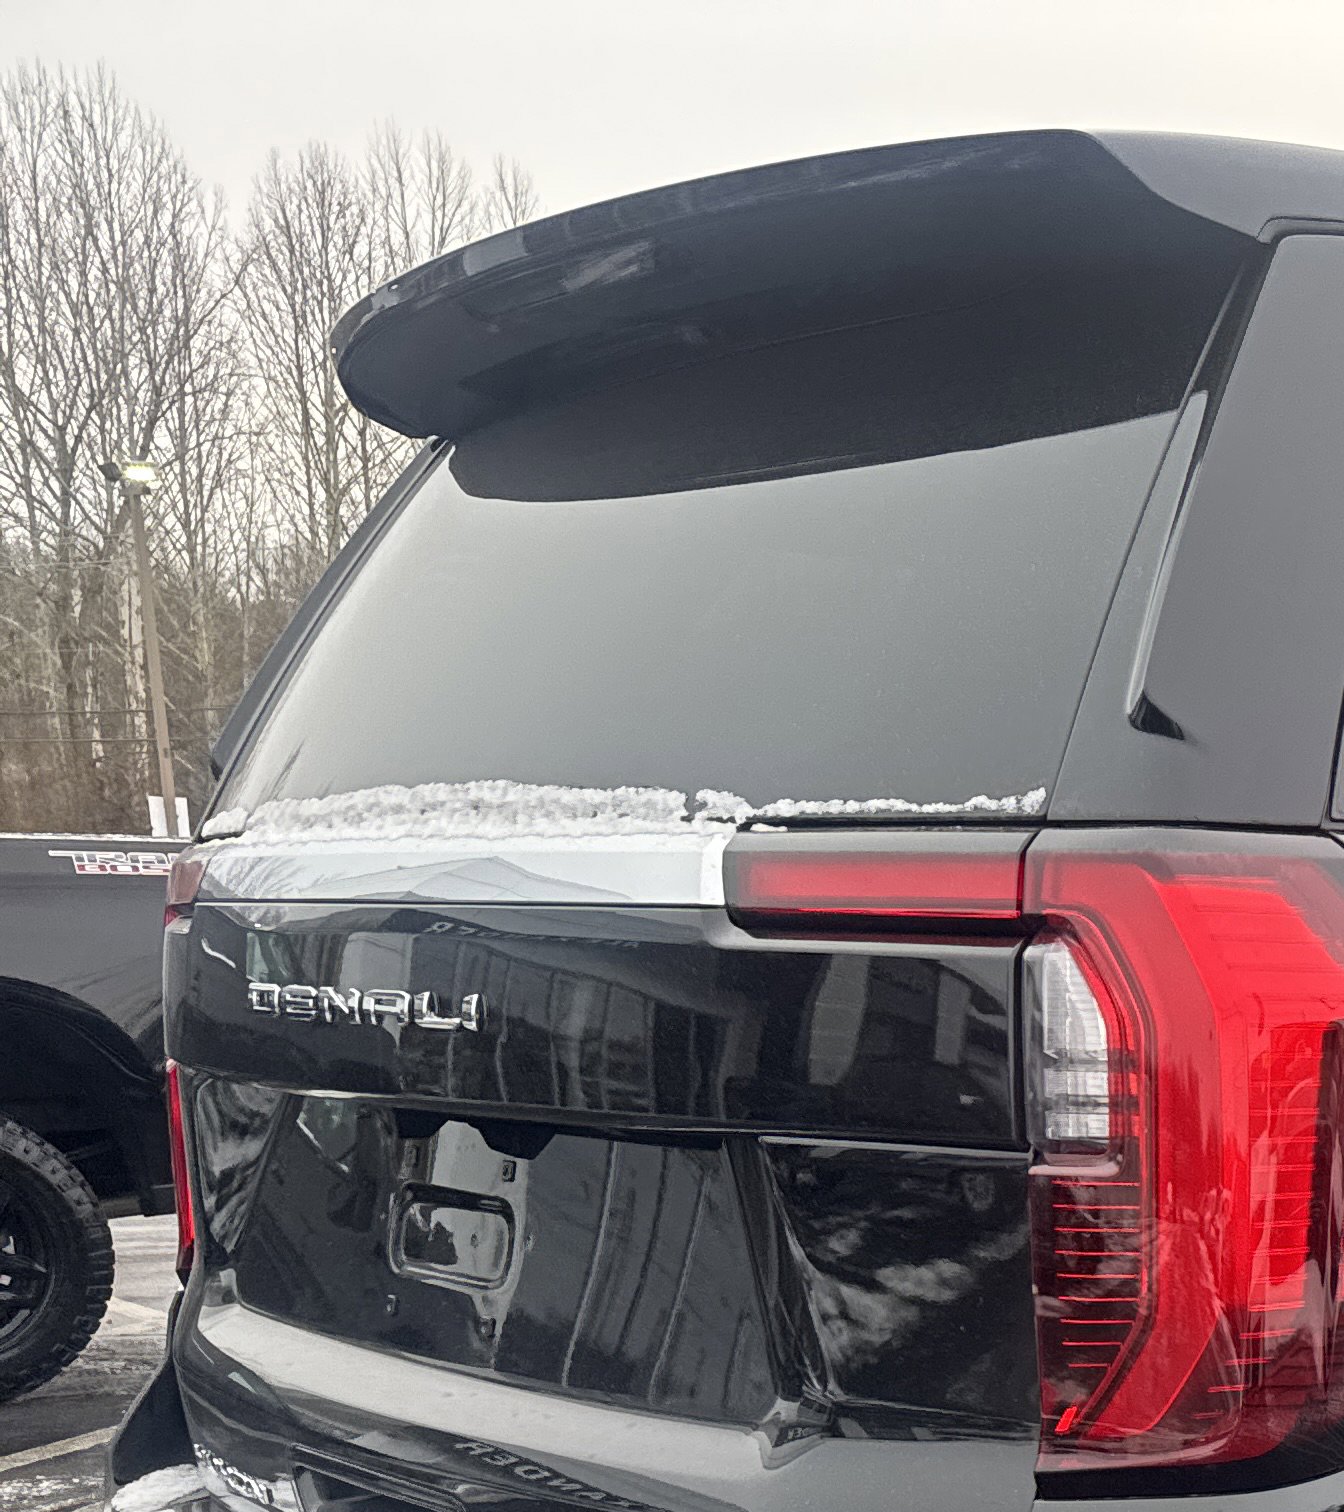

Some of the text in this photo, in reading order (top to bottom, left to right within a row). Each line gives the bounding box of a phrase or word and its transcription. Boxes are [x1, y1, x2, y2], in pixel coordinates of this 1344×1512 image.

[48, 849, 180, 864] TRA
[74, 863, 171, 876] BOS
[247, 981, 486, 1033] DENALI
